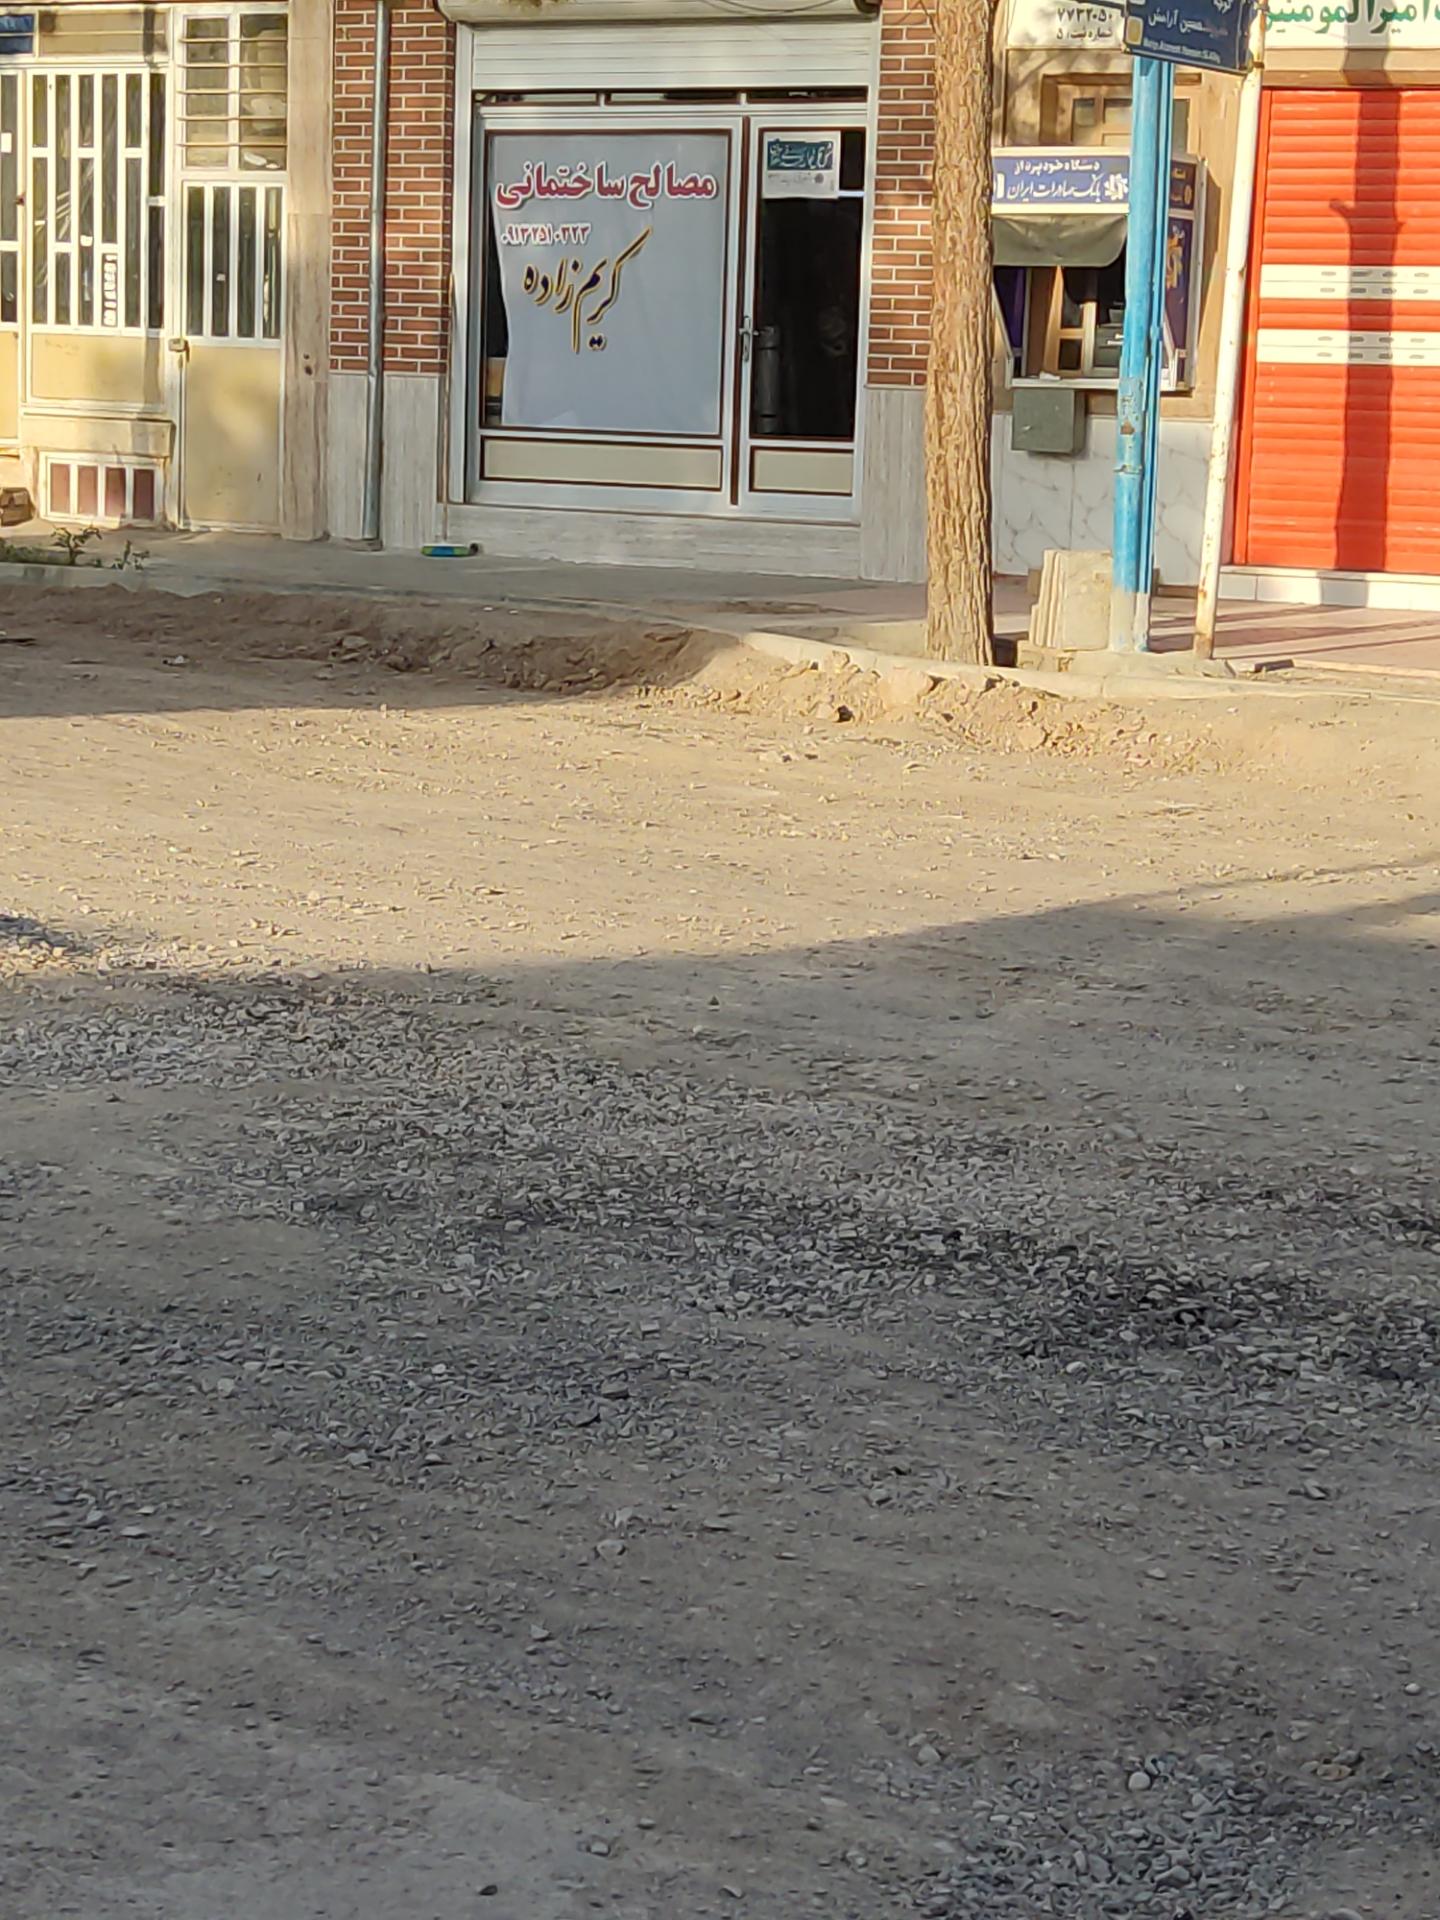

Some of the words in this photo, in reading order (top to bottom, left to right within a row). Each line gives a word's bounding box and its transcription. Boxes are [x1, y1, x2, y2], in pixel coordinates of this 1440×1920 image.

[495, 160, 627, 209] ساختمانی
[1064, 159, 1101, 172] دستگاه
[627, 162, 721, 210] مصالح
[1006, 180, 1034, 202] ایران
[1033, 180, 1078, 198] صادرات
[1072, 172, 1106, 203] بانک
[523, 257, 583, 315] زاده
[573, 225, 653, 353] کریم
